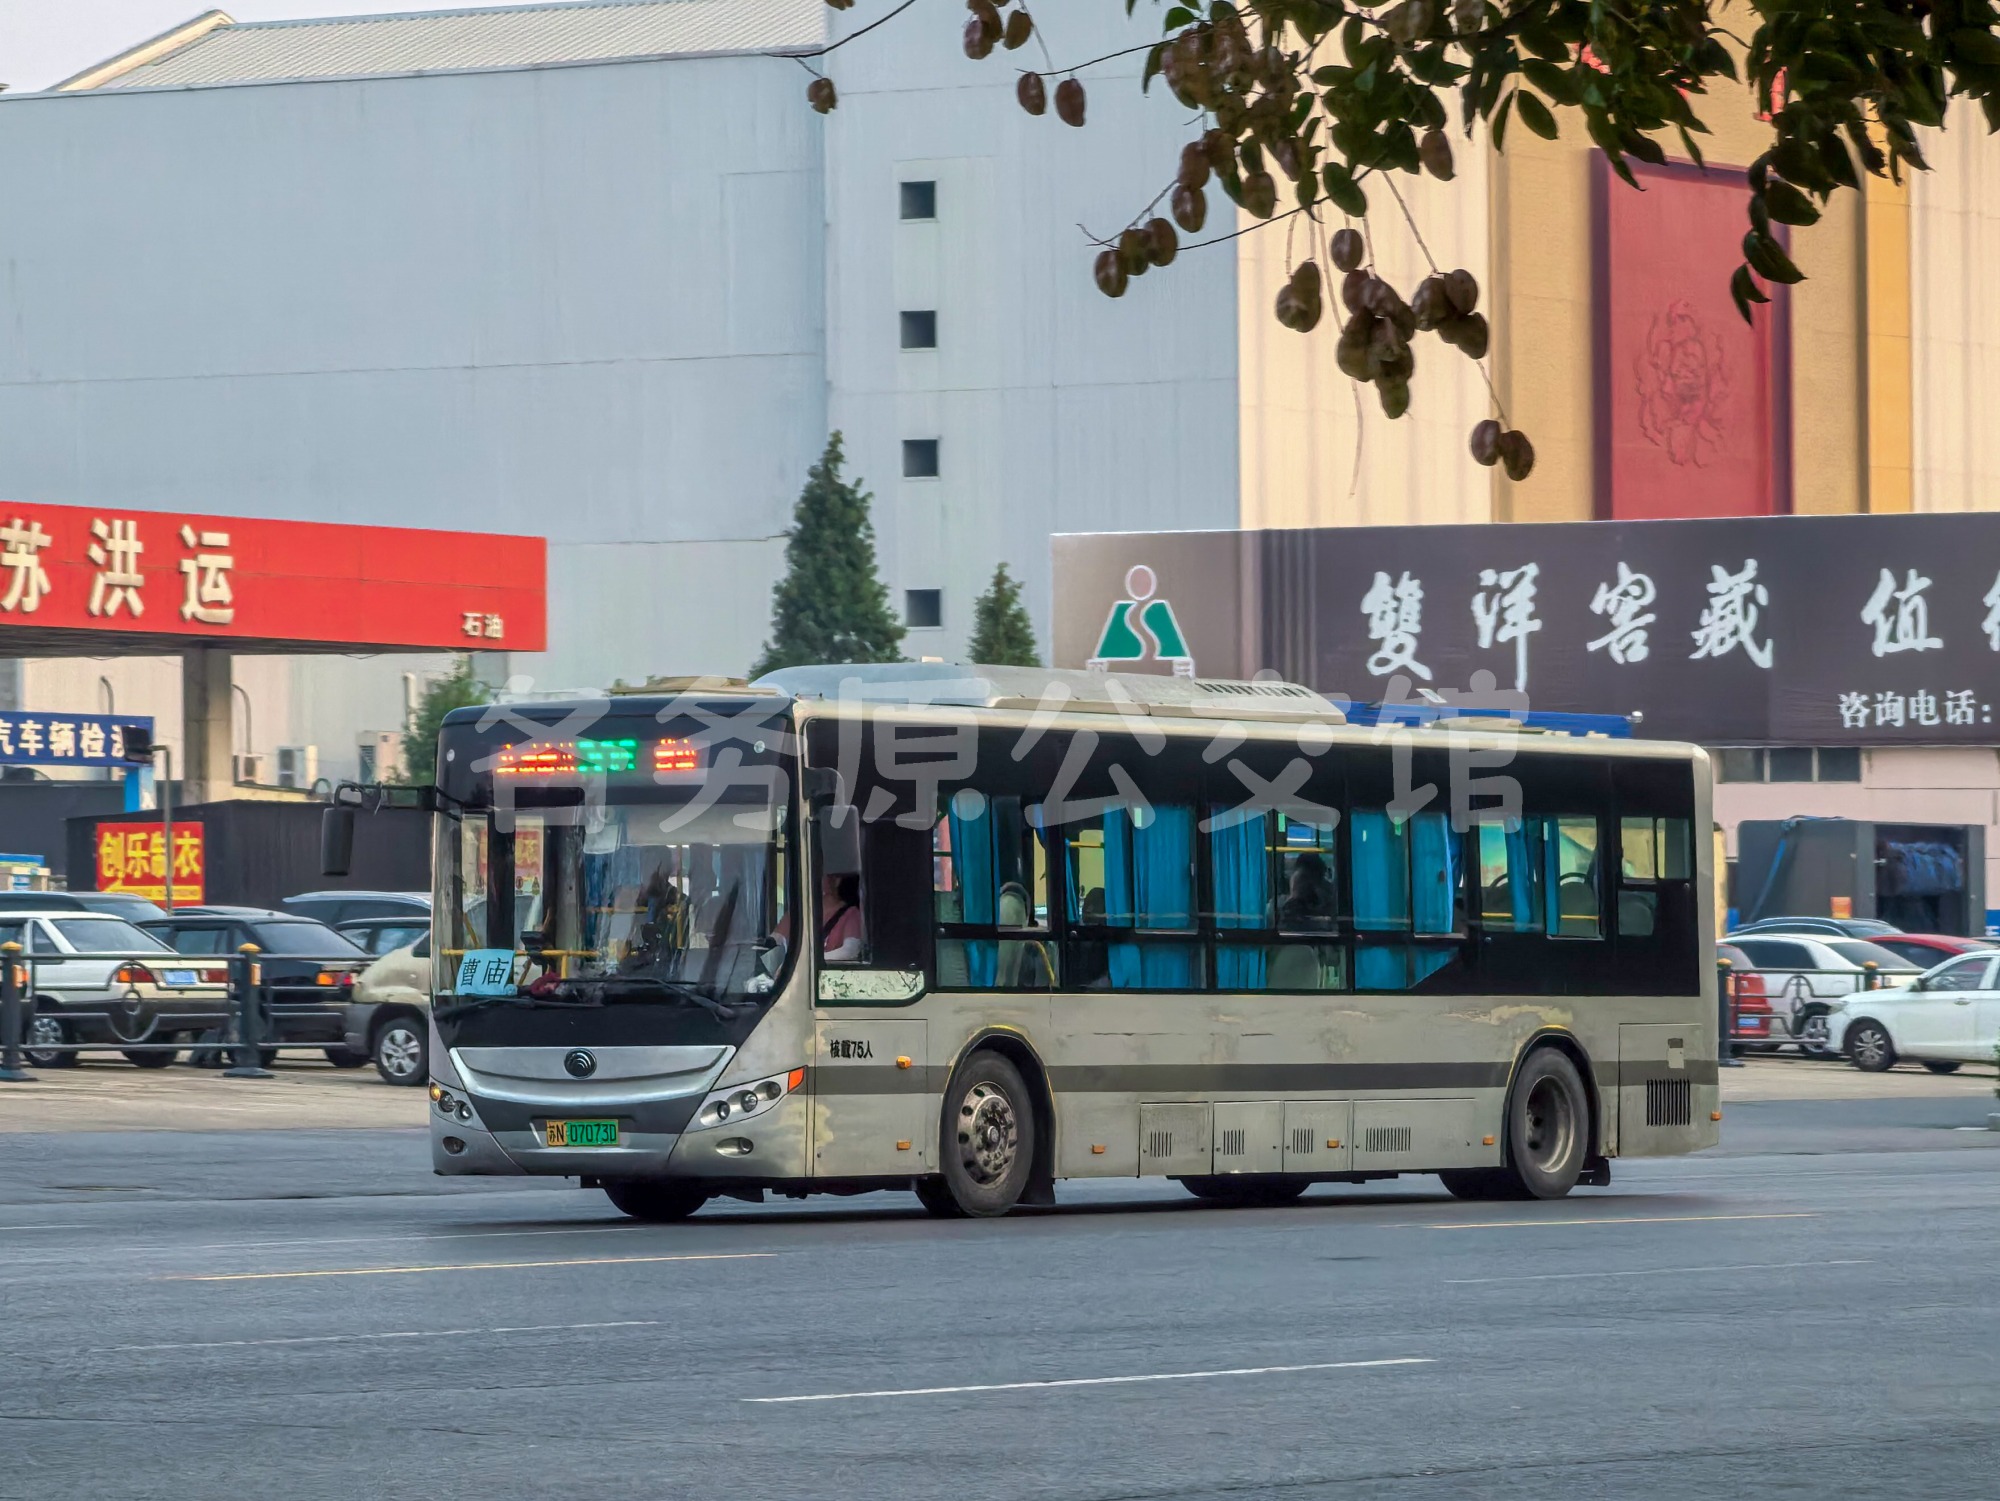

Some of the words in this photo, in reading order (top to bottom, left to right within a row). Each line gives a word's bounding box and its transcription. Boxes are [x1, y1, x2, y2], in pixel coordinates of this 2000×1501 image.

[0, 517, 234, 624] 苏洪运
[462, 612, 504, 638] 石油
[1860, 567, 2000, 658] 值
[460, 957, 509, 987] 曹庙
